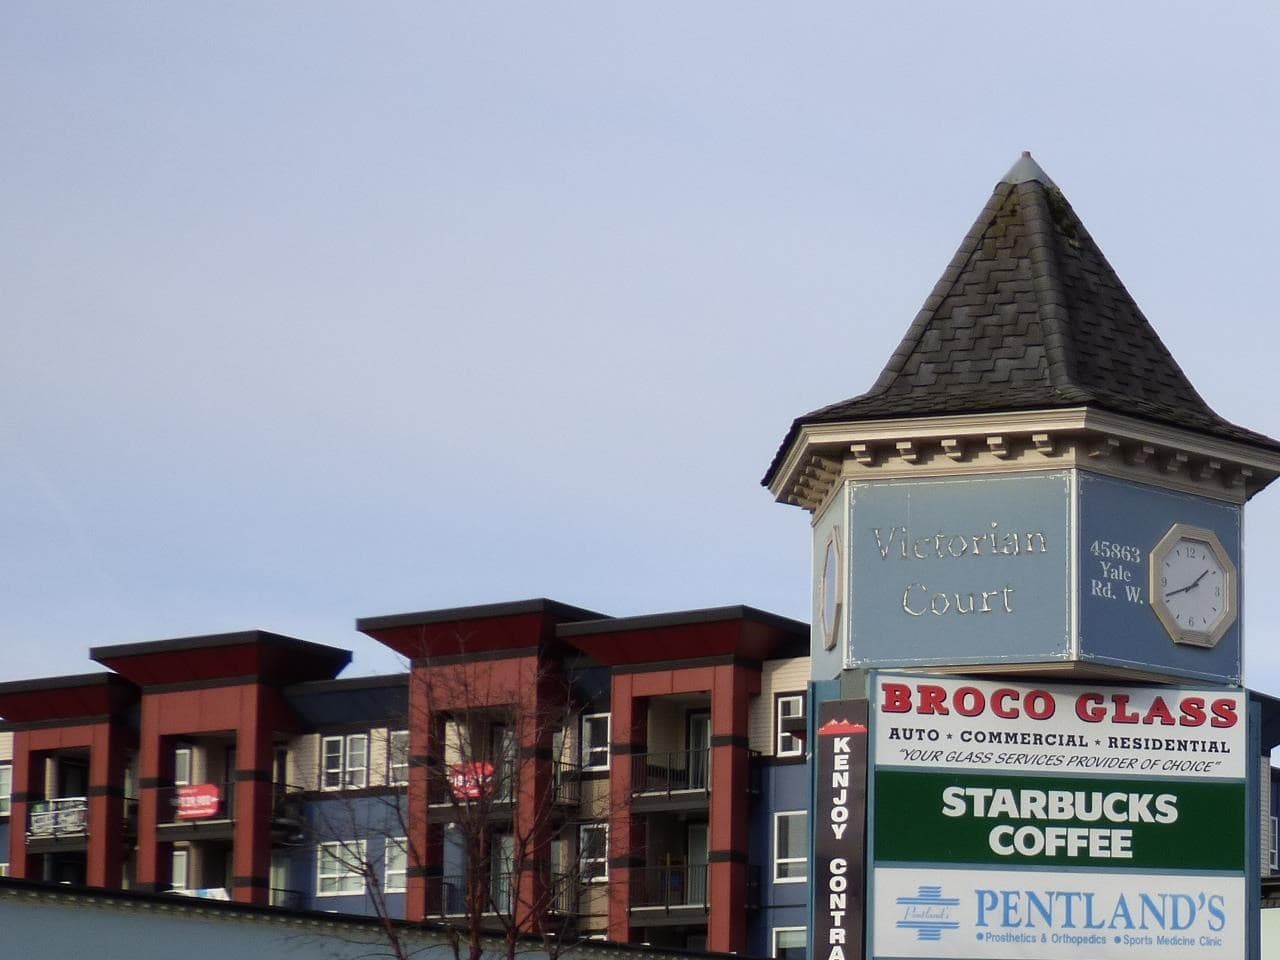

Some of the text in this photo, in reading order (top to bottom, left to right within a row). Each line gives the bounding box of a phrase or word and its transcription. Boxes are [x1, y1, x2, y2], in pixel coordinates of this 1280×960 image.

[873, 521, 1048, 560] Victorian
[1090, 540, 1140, 563] 45863
[1186, 547, 1196, 559] 12
[1100, 561, 1132, 582] Yale
[903, 582, 1016, 616] Court
[1091, 579, 1144, 604] Rd. W.
[881, 682, 1238, 728] BROCO GLASS
[889, 727, 1231, 753] AUTO COMMERCIAL RESIDENTIAL
[946, 751, 994, 764] GLASS
[995, 753, 1065, 767] SERVICES
[1066, 755, 1138, 770] PROVIDER
[1140, 759, 1161, 771] OF
[831, 736, 850, 841] KENJOY
[942, 786, 1179, 824] STARBUCKS
[988, 824, 1133, 858] COFFEE
[974, 889, 1226, 932] PENTLAND'S
[985, 932, 1222, 946] Prosthetics & Orthopedics Sports Medicine Clinic
